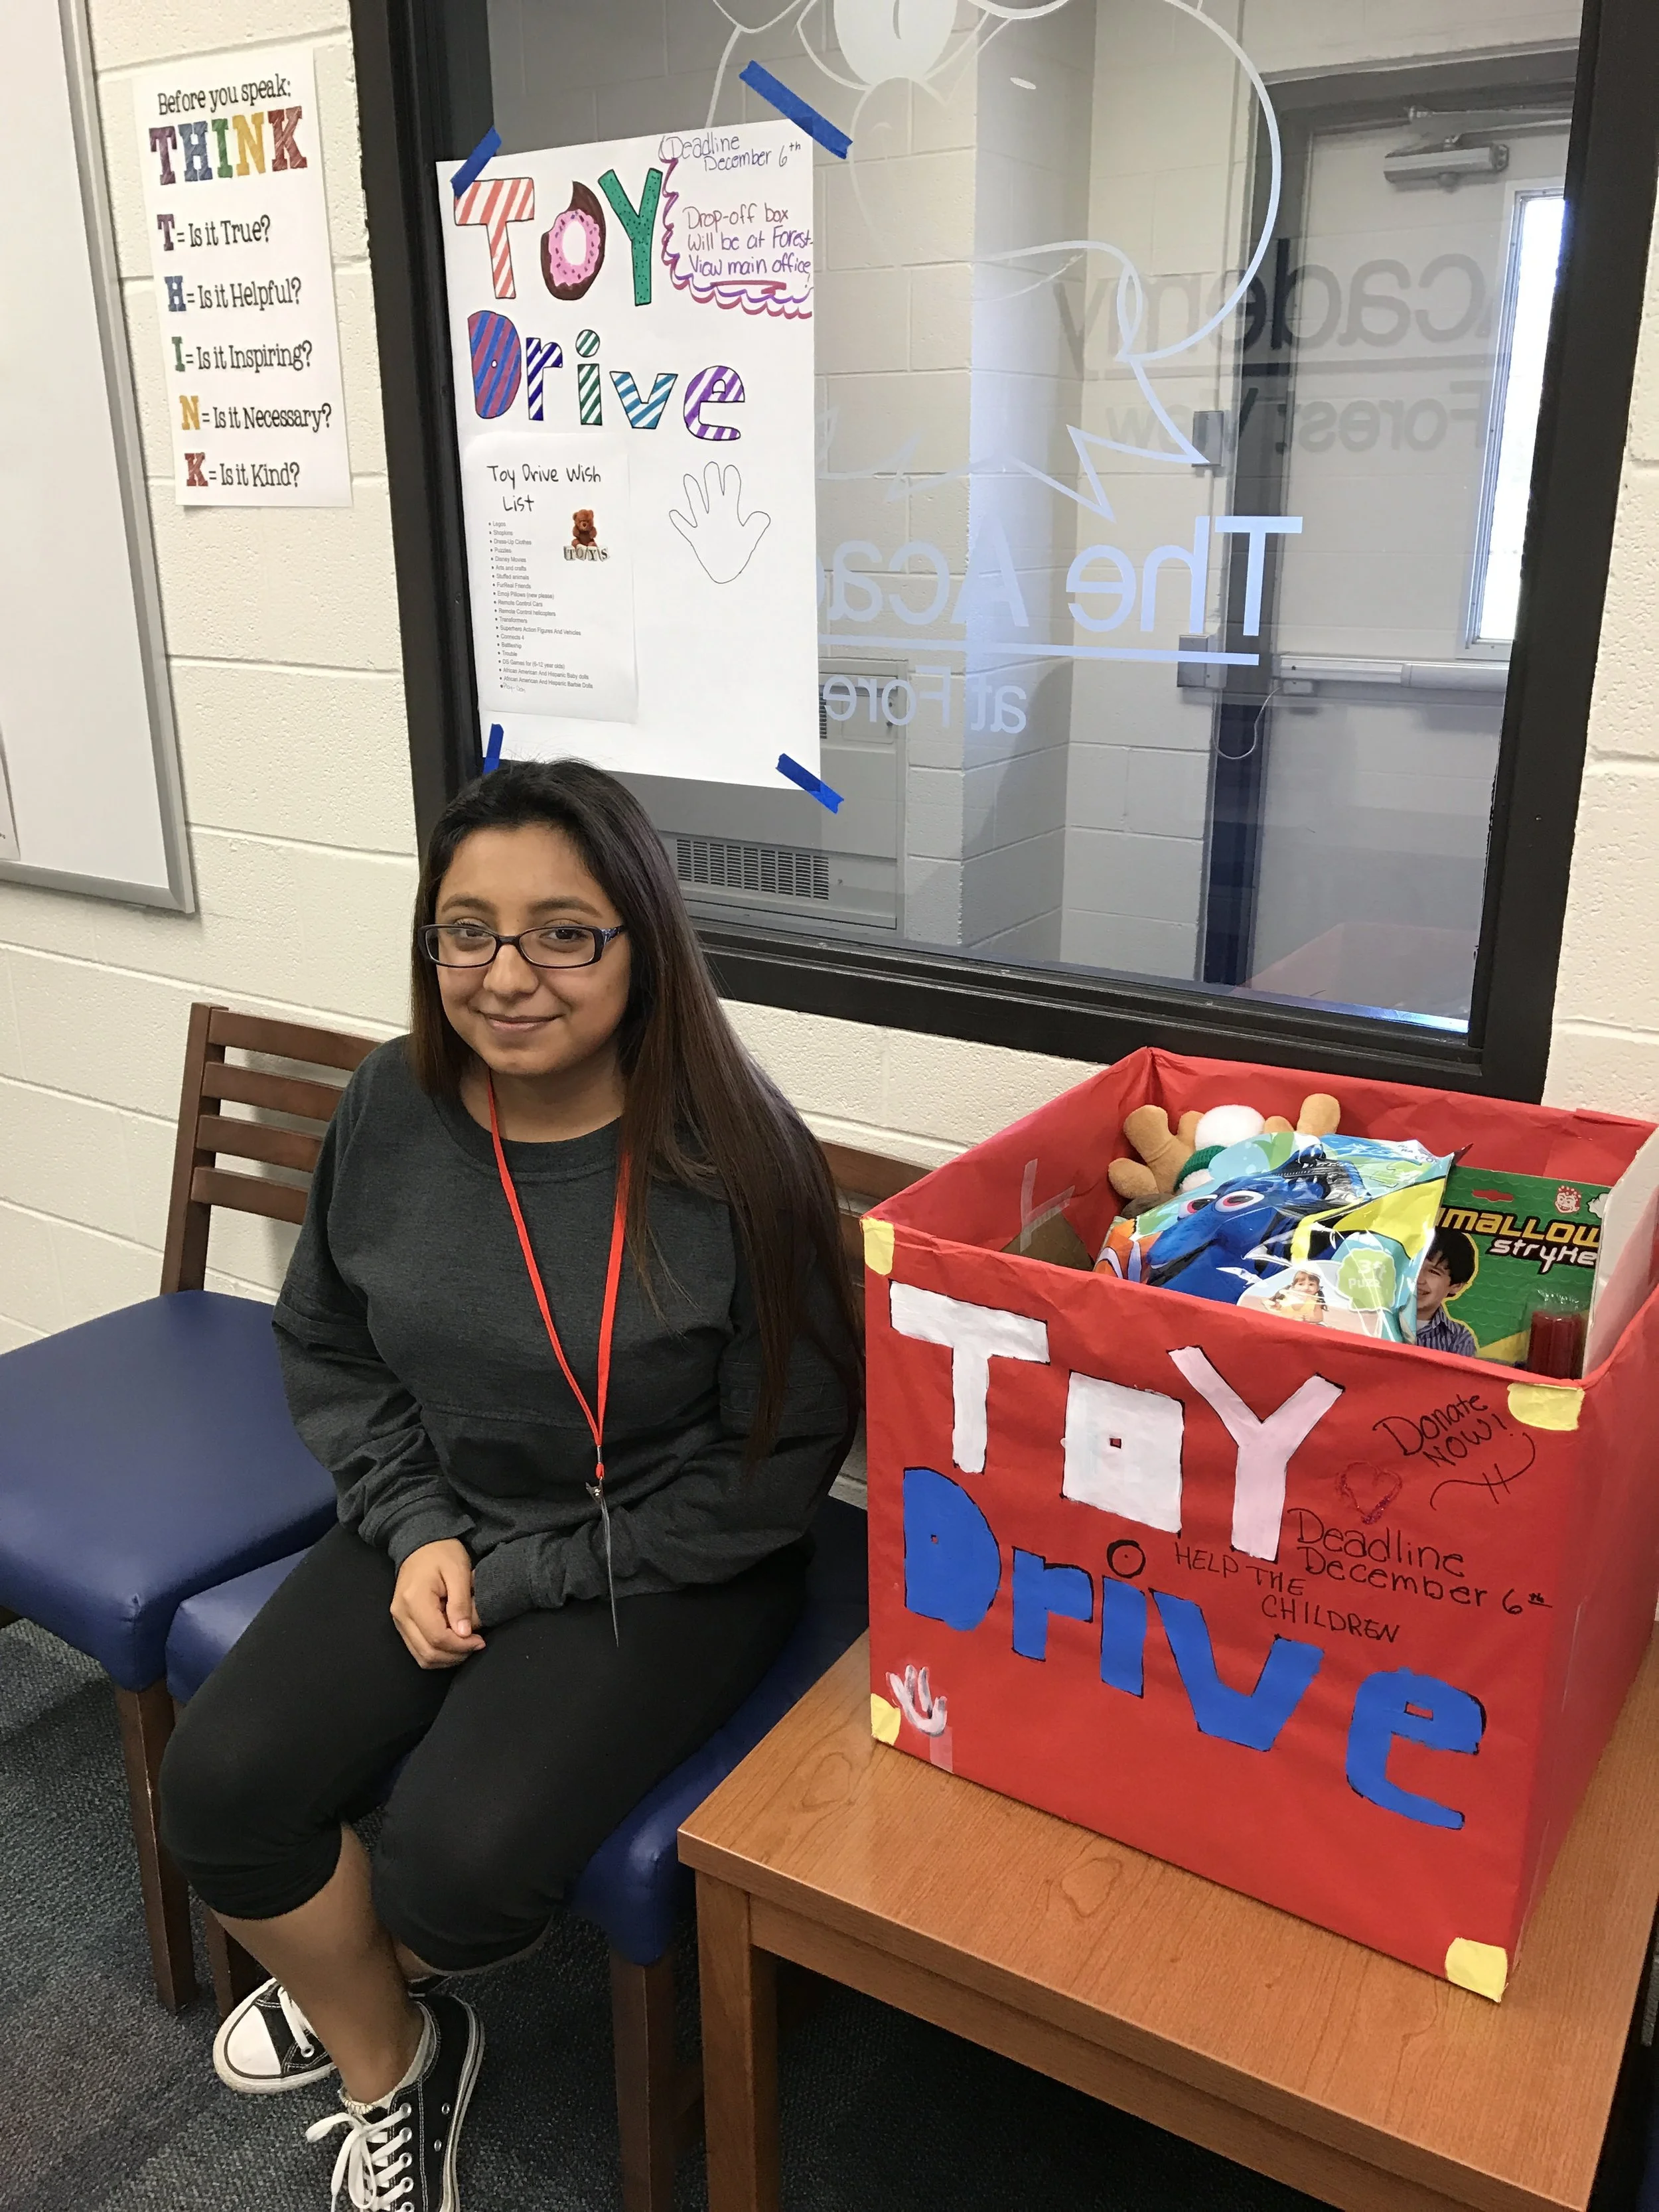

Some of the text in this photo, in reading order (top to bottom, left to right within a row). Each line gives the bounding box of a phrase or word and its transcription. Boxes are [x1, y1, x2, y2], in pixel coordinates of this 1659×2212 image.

[157, 73, 291, 115] Before you speak:
[149, 106, 308, 186] THINK
[703, 149, 772, 172] December
[188, 223, 202, 248] Is
[204, 221, 218, 246] it
[220, 214, 271, 245] True?
[682, 202, 789, 233] Drop-off box
[454, 167, 664, 307] TOY
[687, 231, 715, 252] Will
[721, 231, 739, 251] be
[747, 230, 765, 250] at
[727, 256, 767, 275] main
[197, 285, 213, 309] Is
[214, 284, 228, 308] it
[230, 276, 301, 311] Helpful?
[196, 346, 211, 370] Is
[213, 346, 226, 369] it
[228, 339, 313, 373] Inspiring?
[467, 310, 746, 441] Drive
[212, 406, 226, 429] Is
[228, 406, 241, 429] it
[243, 402, 332, 433] Necessary?
[220, 463, 234, 486] Is
[236, 463, 248, 486] it
[251, 461, 300, 488] Kind?
[486, 463, 601, 490] Toy Drive Wish
[502, 494, 534, 512] List
[567, 548, 609, 561] TOYS
[889, 1279, 1345, 1562] TOY
[1372, 1394, 1488, 1455] Donate
[1287, 1507, 1465, 1578] Deadline
[1175, 1541, 1307, 1596] HELP THE
[1296, 1546, 1488, 1607] December
[1261, 1593, 1400, 1643] CHILDREN
[902, 1466, 1486, 1830] Drive
